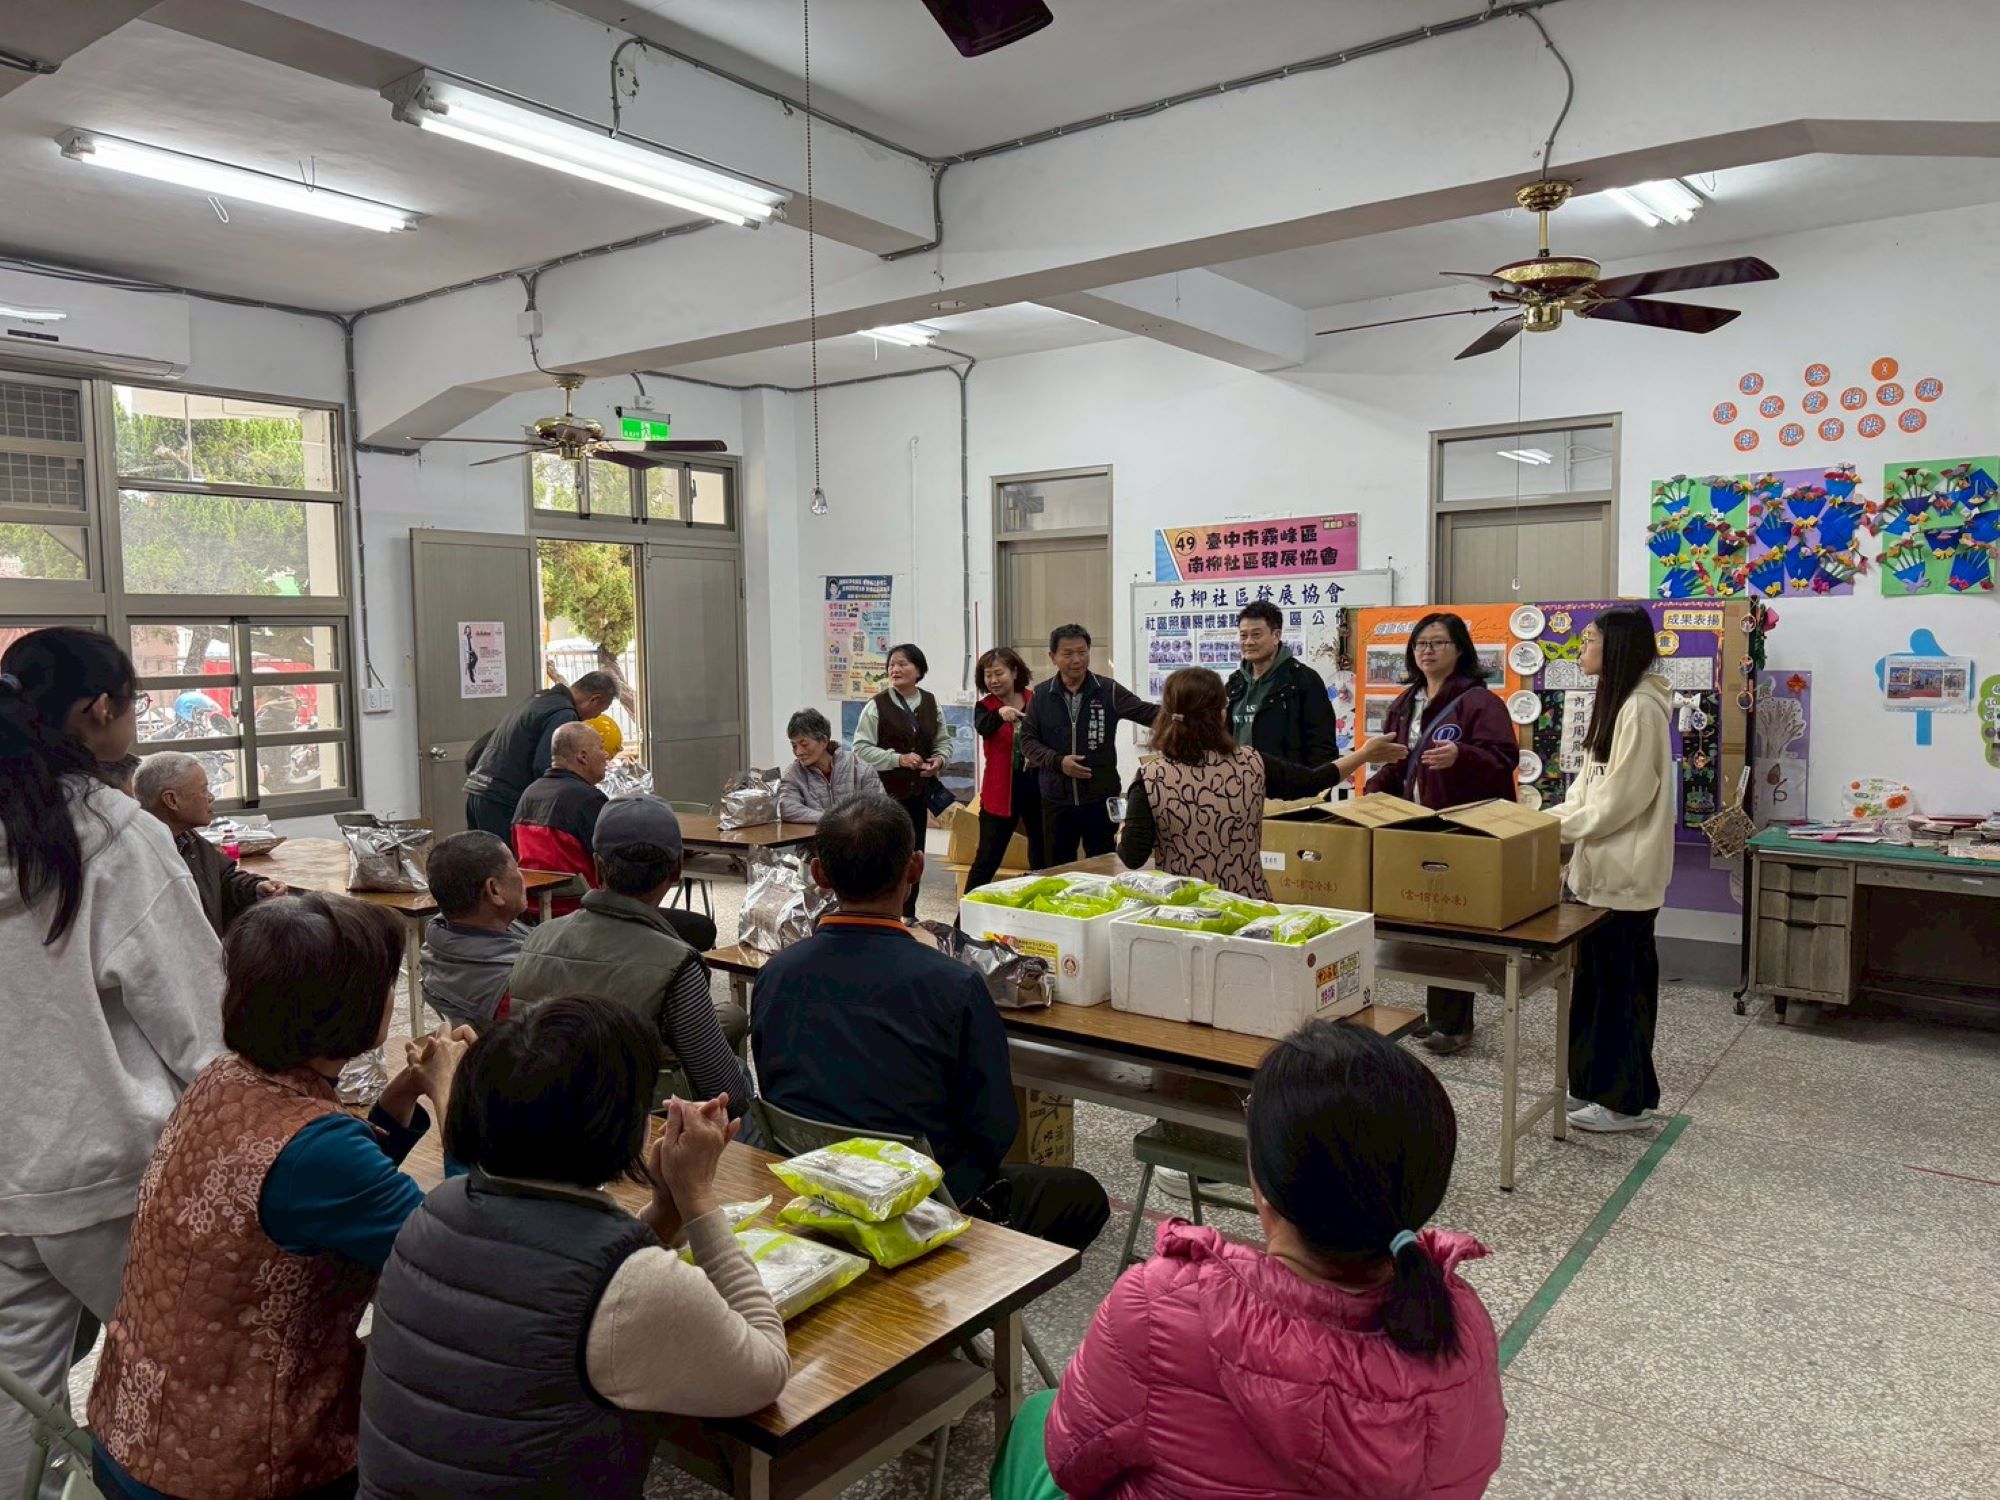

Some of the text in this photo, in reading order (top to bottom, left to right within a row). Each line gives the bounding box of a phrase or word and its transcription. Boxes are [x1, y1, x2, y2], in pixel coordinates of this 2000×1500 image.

[1175, 525, 1317, 551] 49 臺中市霧峰區
[1188, 547, 1338, 573] 南柳社區發展協會
[1170, 582, 1345, 609] 南柳社區發展協會
[1667, 613, 1720, 626] 成果表揚
